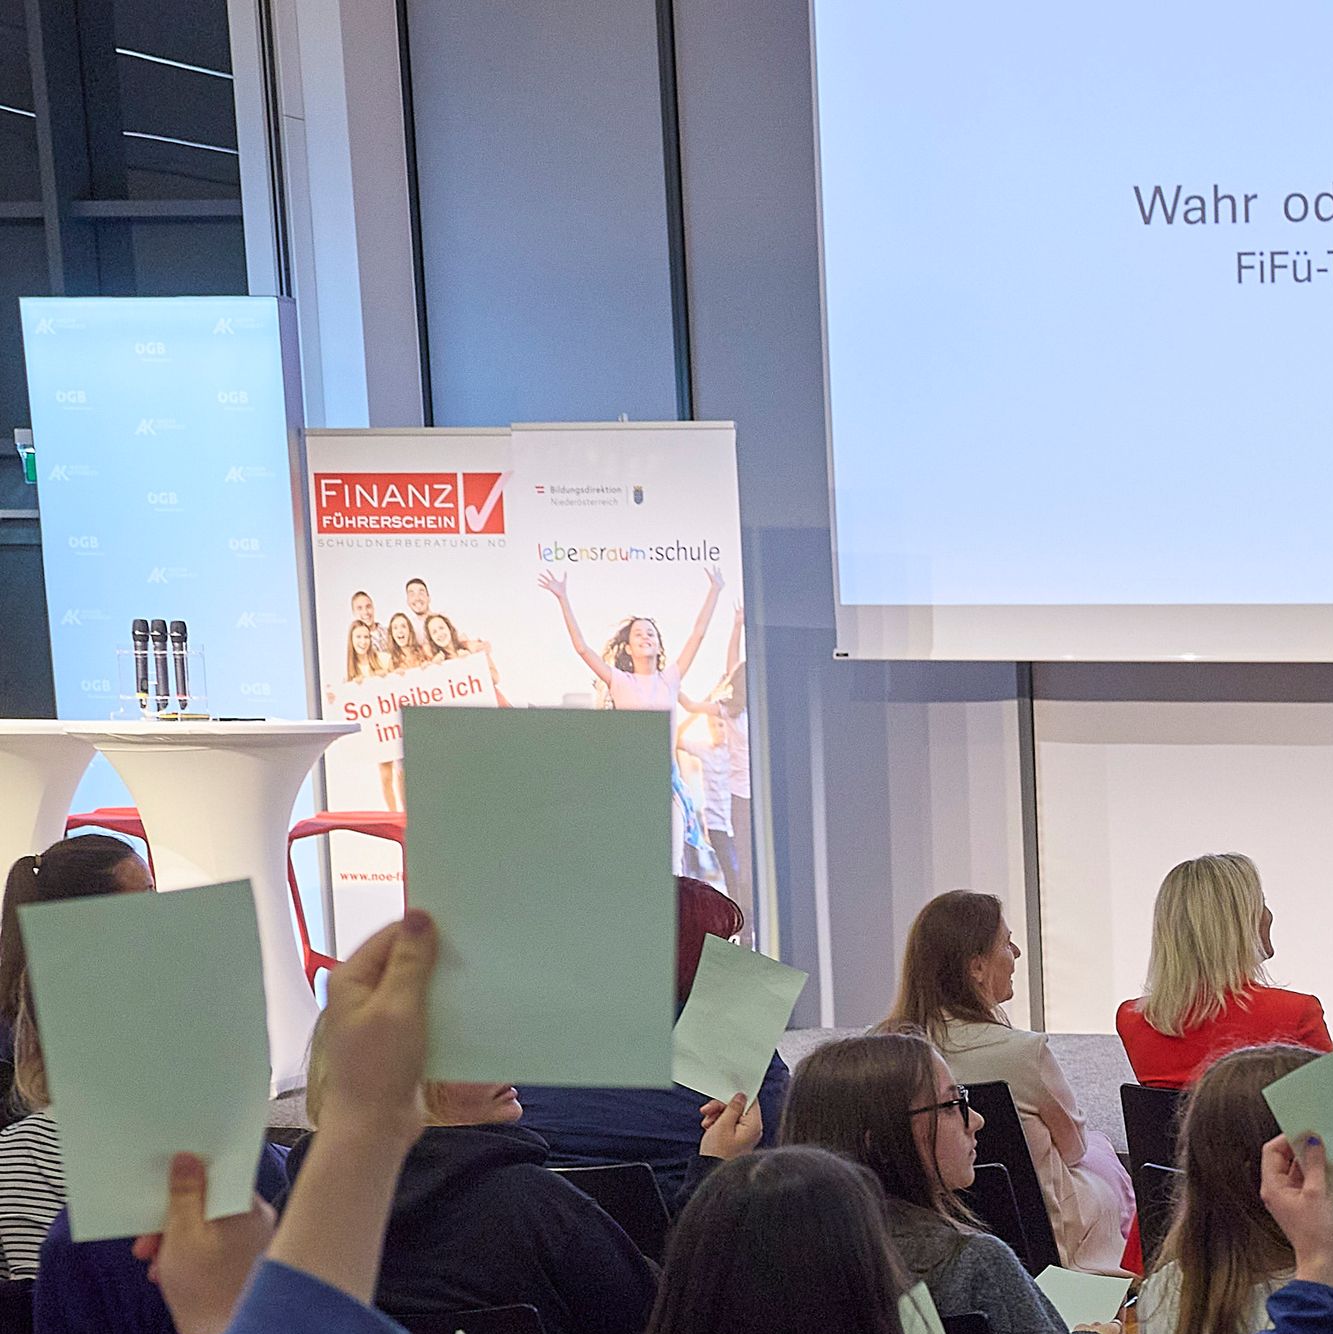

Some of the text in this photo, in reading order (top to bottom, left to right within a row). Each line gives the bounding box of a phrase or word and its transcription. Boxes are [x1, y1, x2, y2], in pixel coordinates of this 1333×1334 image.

[1133, 184, 1258, 226] Wahr
[319, 478, 455, 509] FINANZ
[549, 484, 622, 495] Bildungsdirektion
[549, 496, 619, 506] Niederösterreich
[322, 512, 456, 529] FÜHRERSCHEIN
[317, 537, 507, 548] SCHULDNERBERATUNG NÖ
[344, 675, 483, 722] So bleibe ich
[376, 722, 403, 743] im
